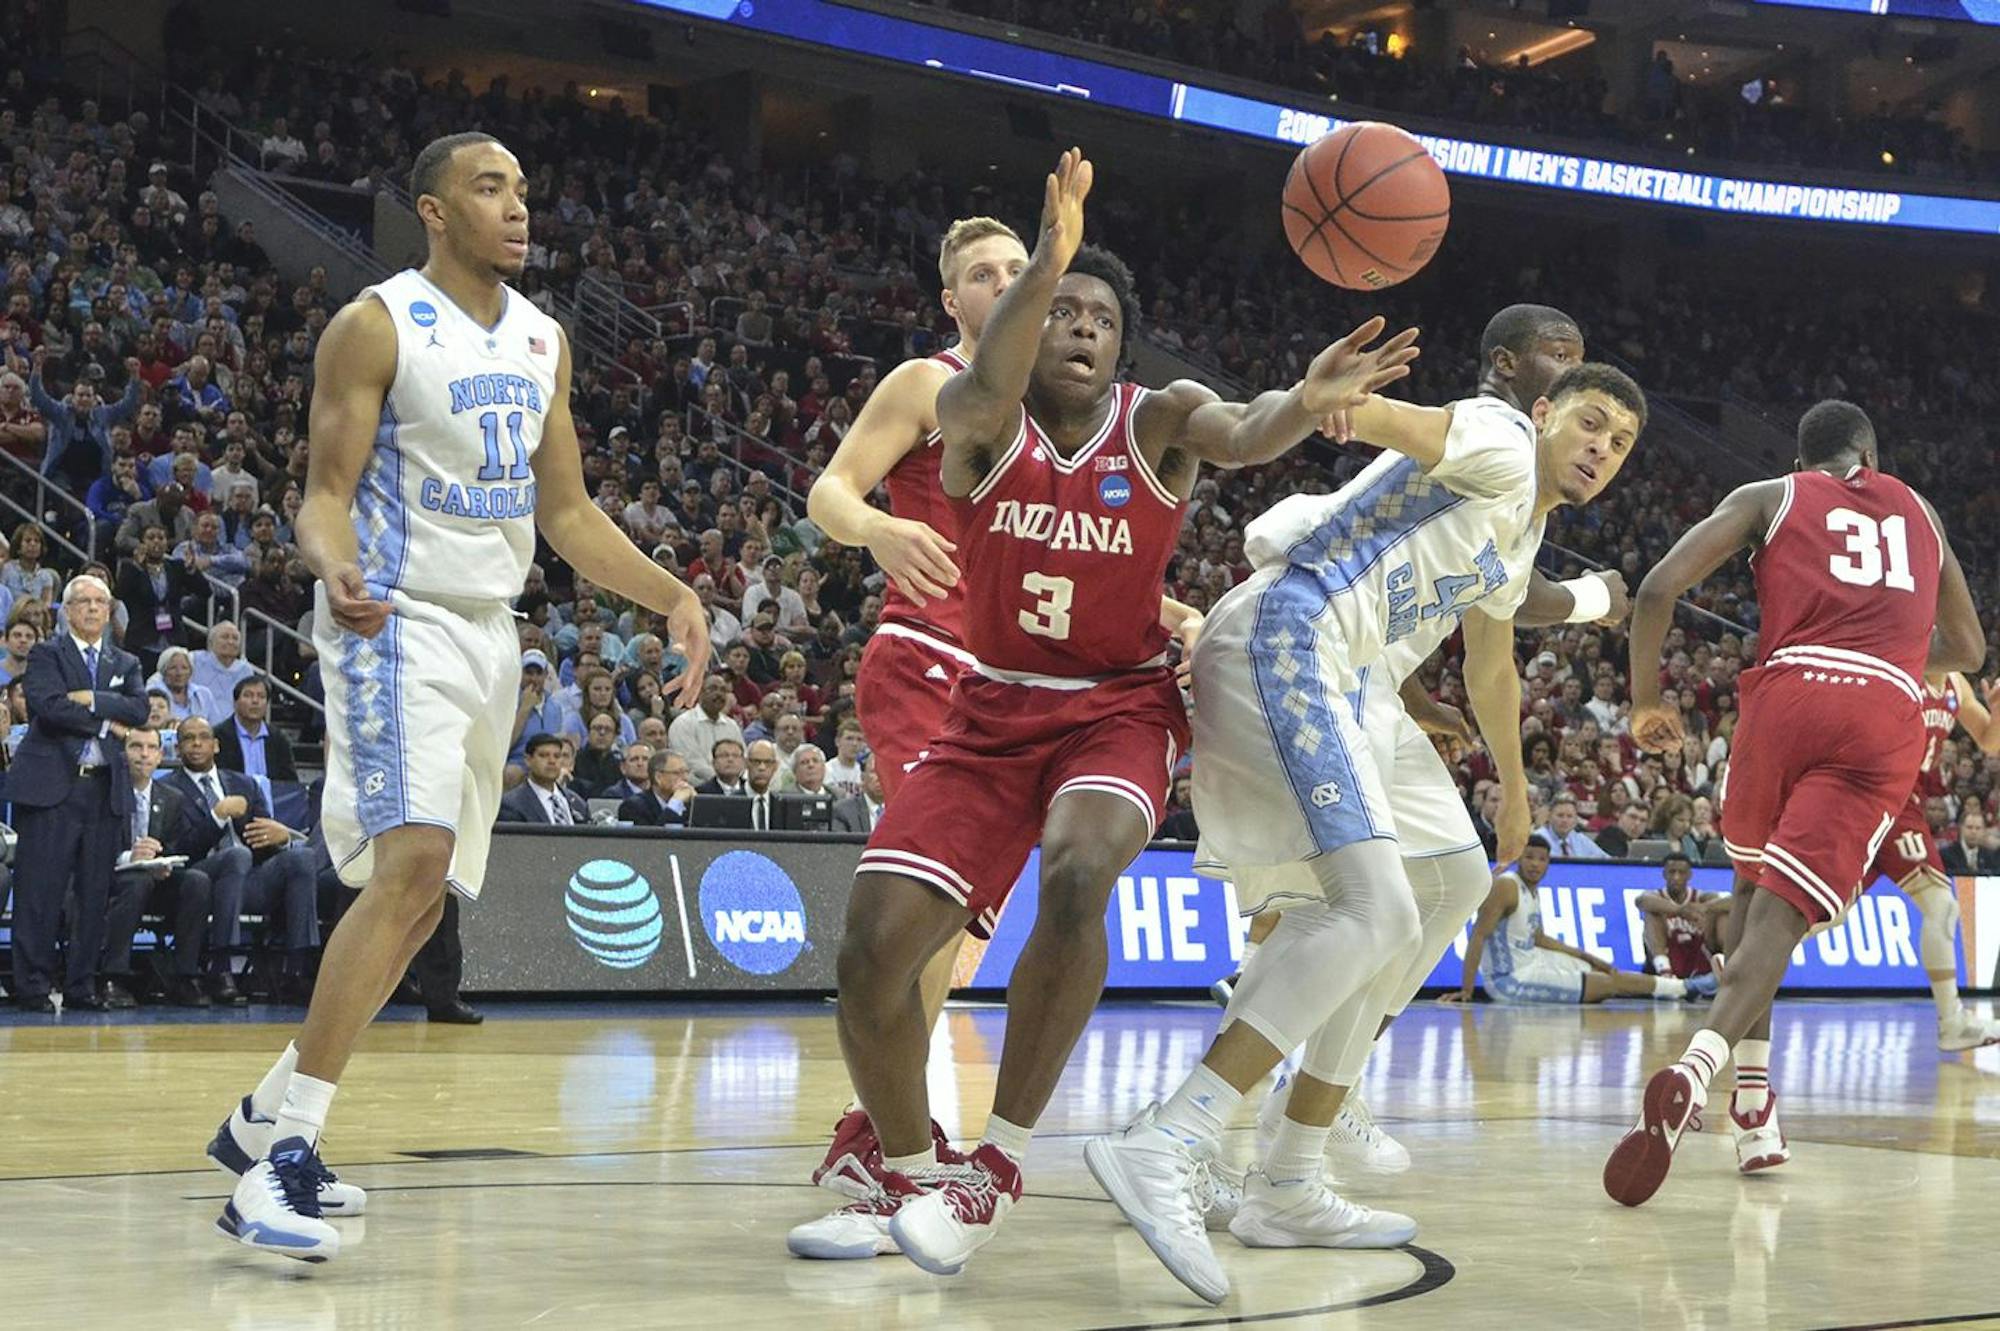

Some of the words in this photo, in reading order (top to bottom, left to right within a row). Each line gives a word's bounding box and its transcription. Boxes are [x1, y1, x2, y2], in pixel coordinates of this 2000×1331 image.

[1506, 149, 1580, 188] MEN'S
[1581, 160, 1713, 207] BASKETBALL
[1717, 179, 1901, 223] CHAMPIONSHIP
[448, 372, 542, 415] NORTH
[477, 411, 530, 481] 11
[988, 499, 1133, 556] INDIANA
[1825, 507, 1915, 593] 31
[1017, 570, 1075, 641] 3
[714, 909, 806, 943] NCAA
[1112, 875, 1208, 962] HE
[1537, 886, 1615, 963] HE
